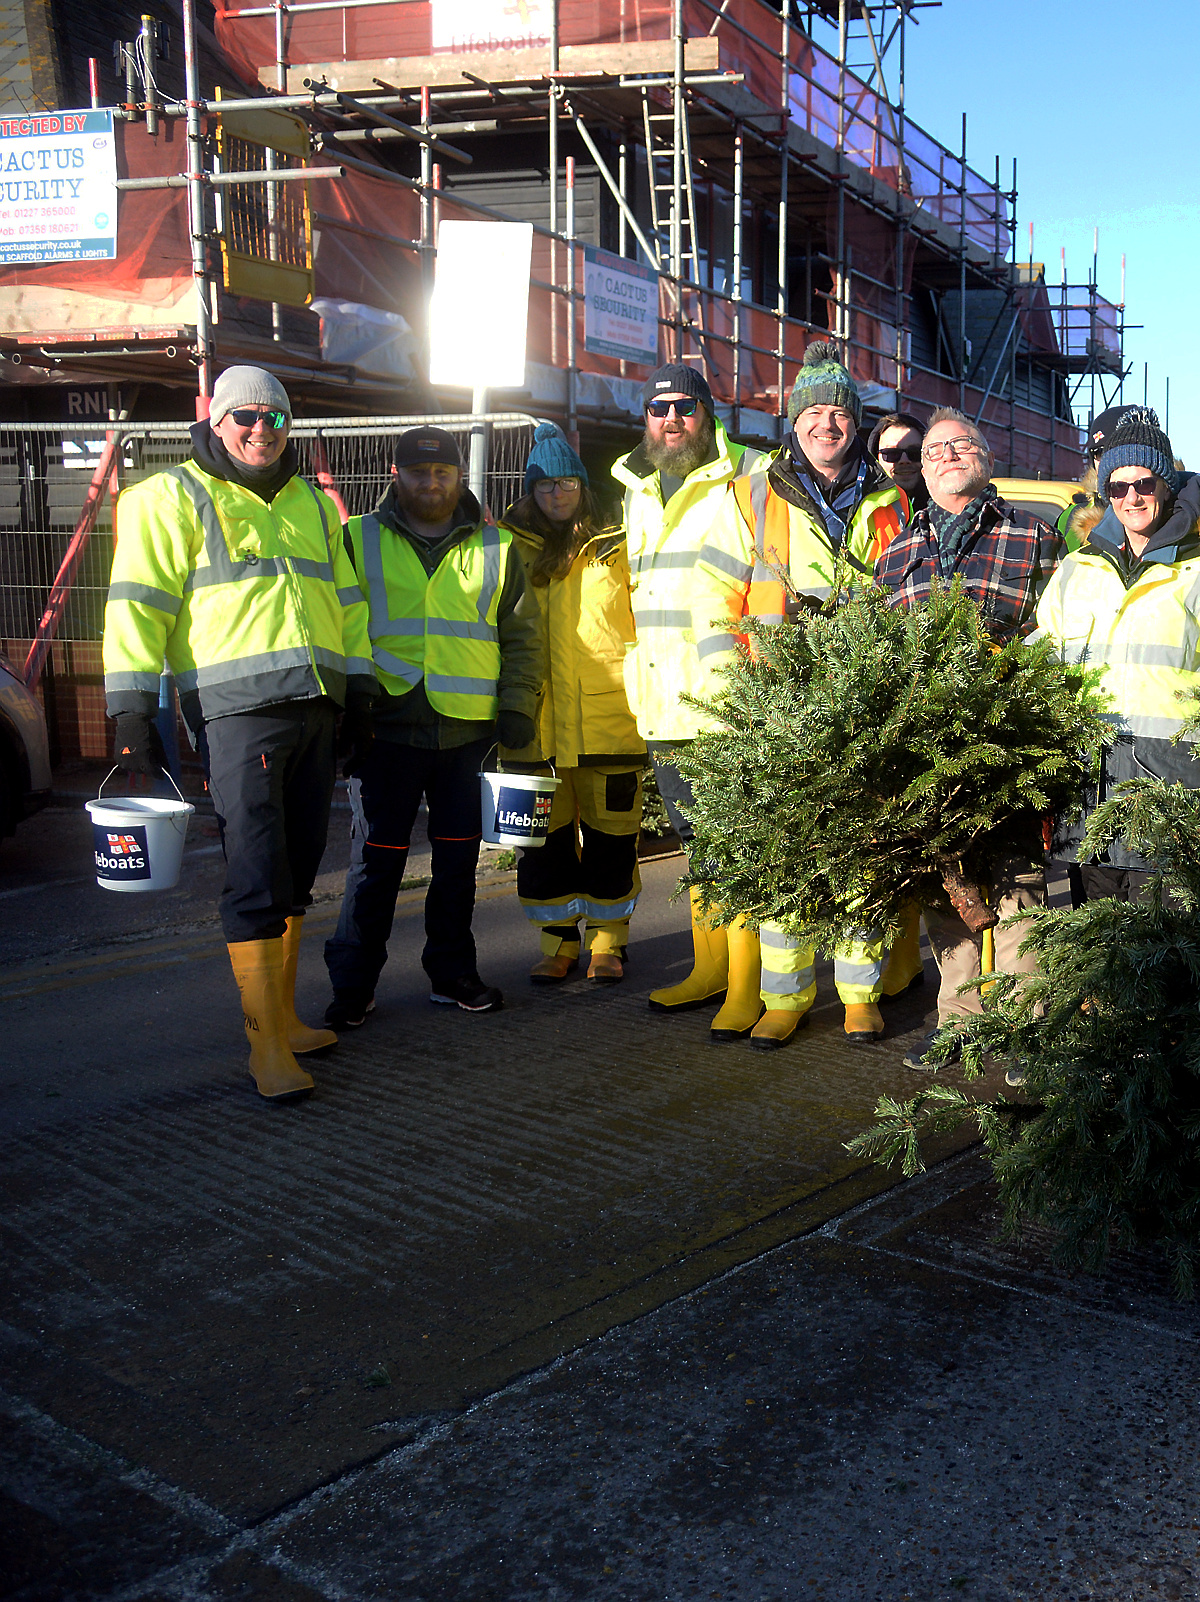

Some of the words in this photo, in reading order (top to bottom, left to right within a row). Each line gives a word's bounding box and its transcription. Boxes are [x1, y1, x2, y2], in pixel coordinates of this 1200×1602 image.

[451, 31, 546, 55] Lifeboats
[63, 114, 87, 132] BY
[0, 147, 84, 173] ACTUS
[14, 207, 39, 219] 01227
[41, 205, 76, 217] 365000
[18, 225, 46, 235] 07358
[48, 223, 79, 234] 180621
[6, 252, 43, 261] SCAFFOLD
[44, 250, 74, 260] ALARMS
[75, 250, 81, 258] &
[82, 248, 108, 258] LIGHTS
[605, 277, 648, 303] CACTUS
[593, 295, 647, 323] SECURITY
